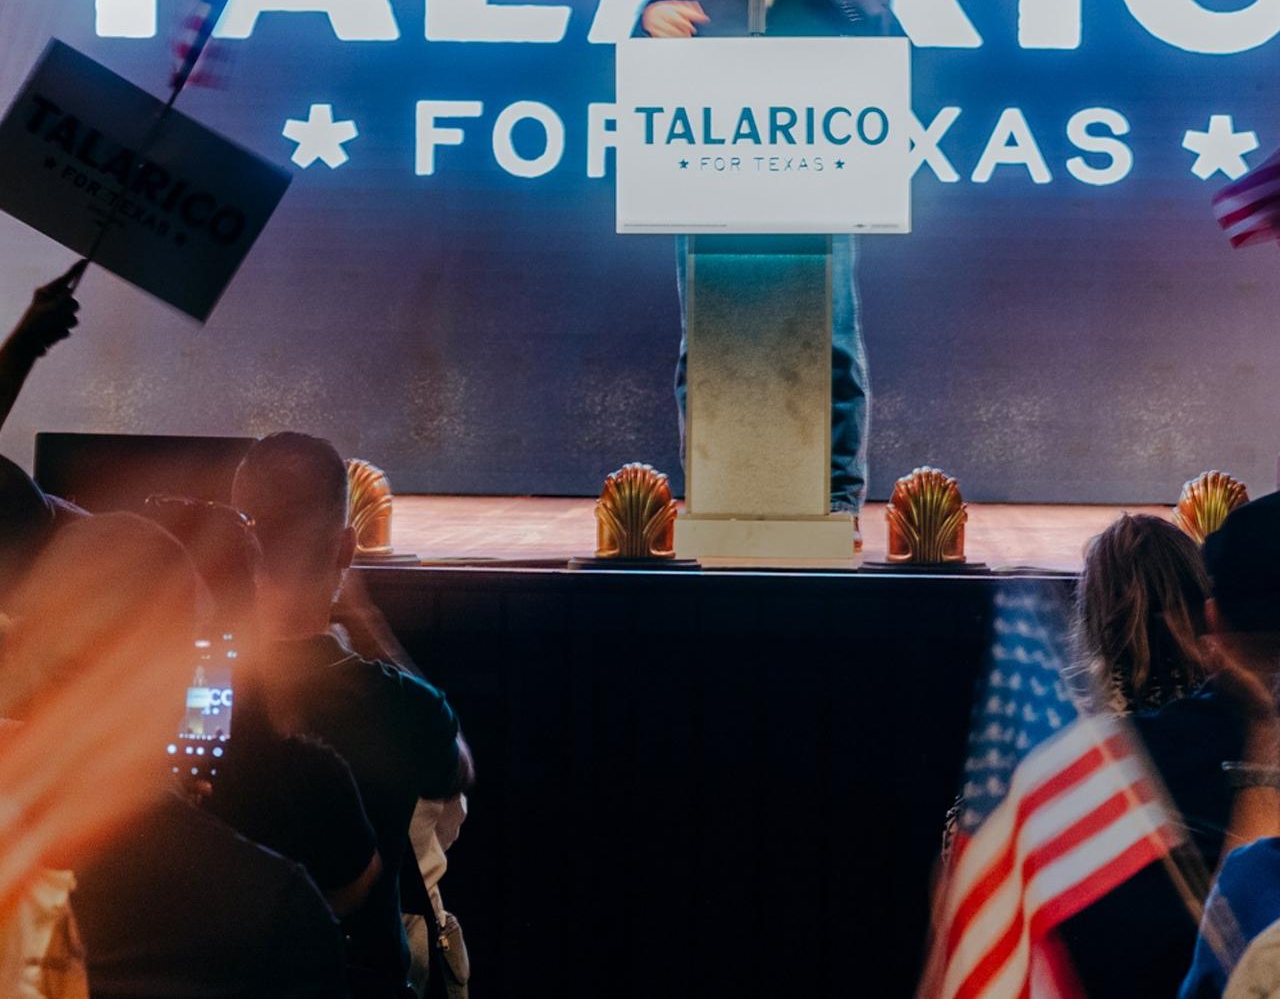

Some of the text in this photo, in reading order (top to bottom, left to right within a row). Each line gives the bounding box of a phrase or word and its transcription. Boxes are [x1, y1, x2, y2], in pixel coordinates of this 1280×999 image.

[634, 106, 889, 146] TALARICO
[909, 106, 1134, 186] XAS
[25, 94, 246, 246] TALARICO
[700, 157, 824, 171] FOR TEXAS
[61, 165, 172, 237] FOR TEXAS
